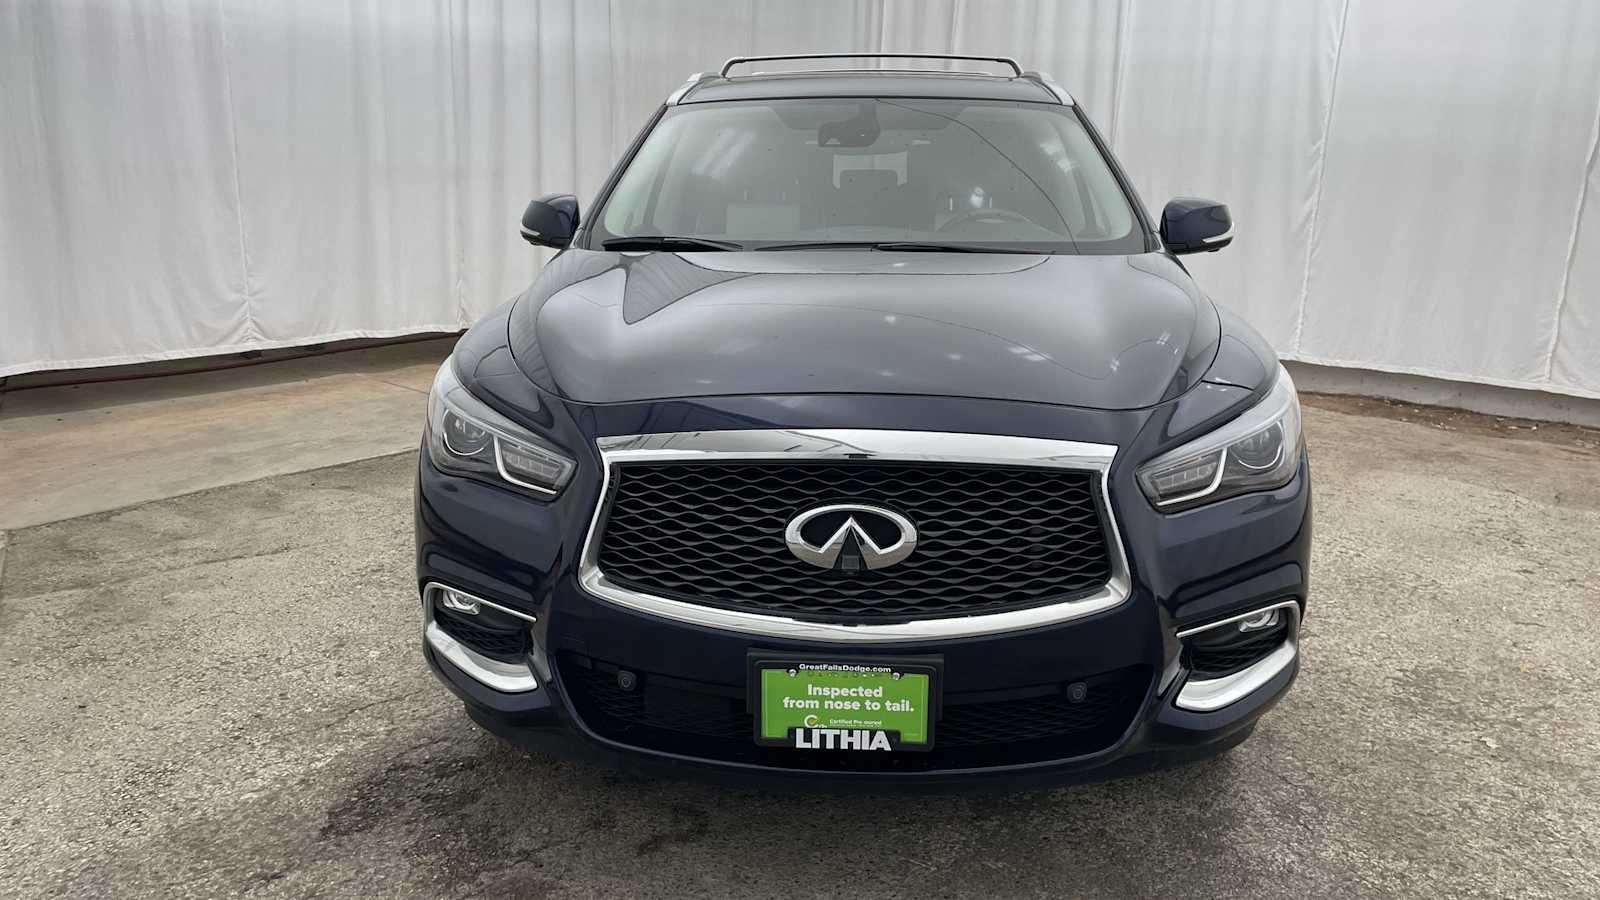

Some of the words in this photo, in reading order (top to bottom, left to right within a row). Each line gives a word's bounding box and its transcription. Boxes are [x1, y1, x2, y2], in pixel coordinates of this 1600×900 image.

[799, 663, 892, 673] GreatFallsDodge.com
[807, 684, 883, 698] Inspected
[783, 697, 820, 709] from
[824, 700, 861, 710] nose
[864, 700, 881, 711] to
[885, 699, 915, 712] tail.
[795, 728, 892, 751] LITHIA
